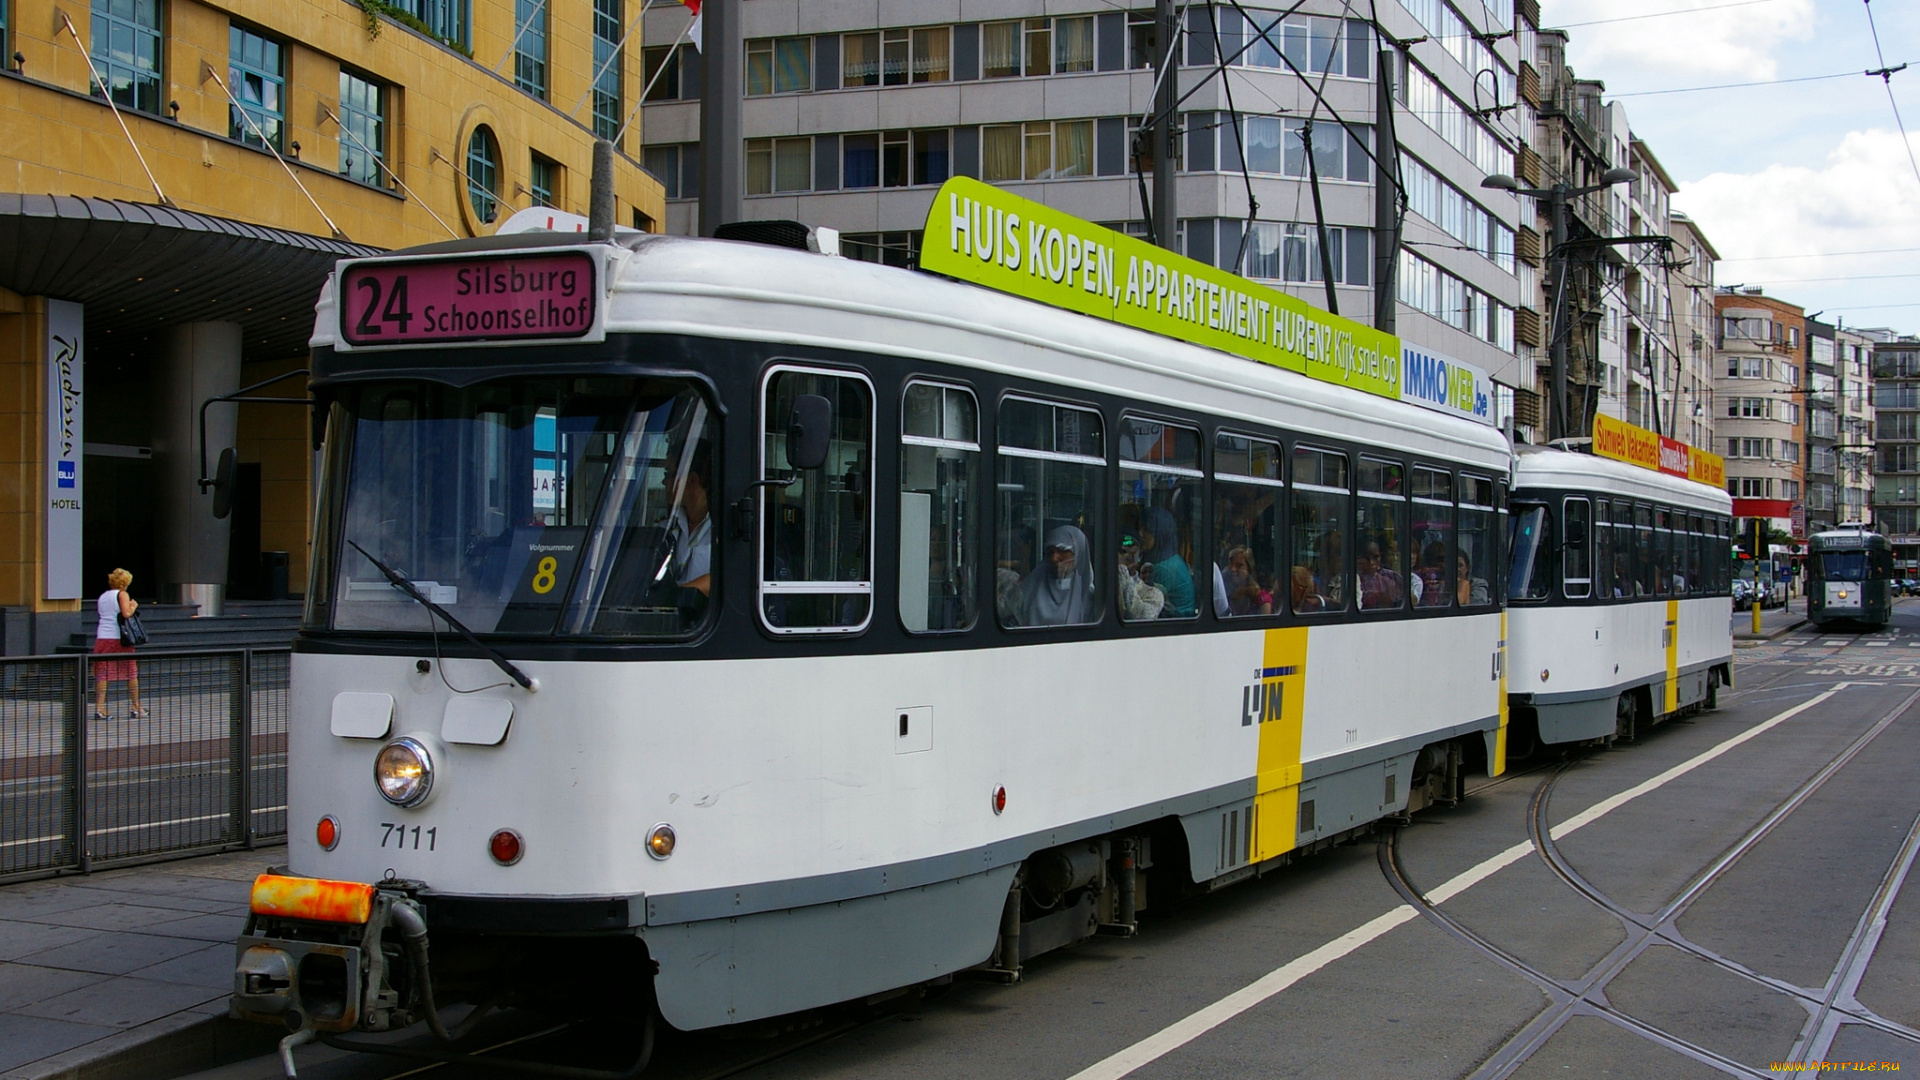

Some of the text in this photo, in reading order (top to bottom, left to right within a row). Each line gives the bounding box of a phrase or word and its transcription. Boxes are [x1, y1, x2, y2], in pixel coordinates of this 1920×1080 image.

[456, 265, 577, 297] Silsburg
[950, 192, 1021, 270] HUIS
[1028, 220, 1121, 308] KOPEN,
[1125, 255, 1270, 344] APPARTEMENT
[1273, 306, 1332, 365] HUREN?
[1334, 328, 1357, 381] Kijk
[1358, 342, 1380, 380] snel
[1382, 356, 1397, 392] op
[355, 275, 413, 336] 24
[423, 297, 587, 333] Schoonselhof
[52, 334, 81, 458] Radisson
[1597, 418, 1625, 457] Sunweb
[1627, 428, 1657, 466] Vakanties
[1659, 438, 1688, 474] Sunweb.be
[52, 499, 81, 510] HOTEL
[529, 543, 575, 552] Volgnummer
[532, 555, 558, 594] 8
[1254, 668, 1261, 679] DE
[1241, 681, 1284, 727] LIJN
[1345, 728, 1358, 744] 7111
[380, 823, 437, 852] 7111
